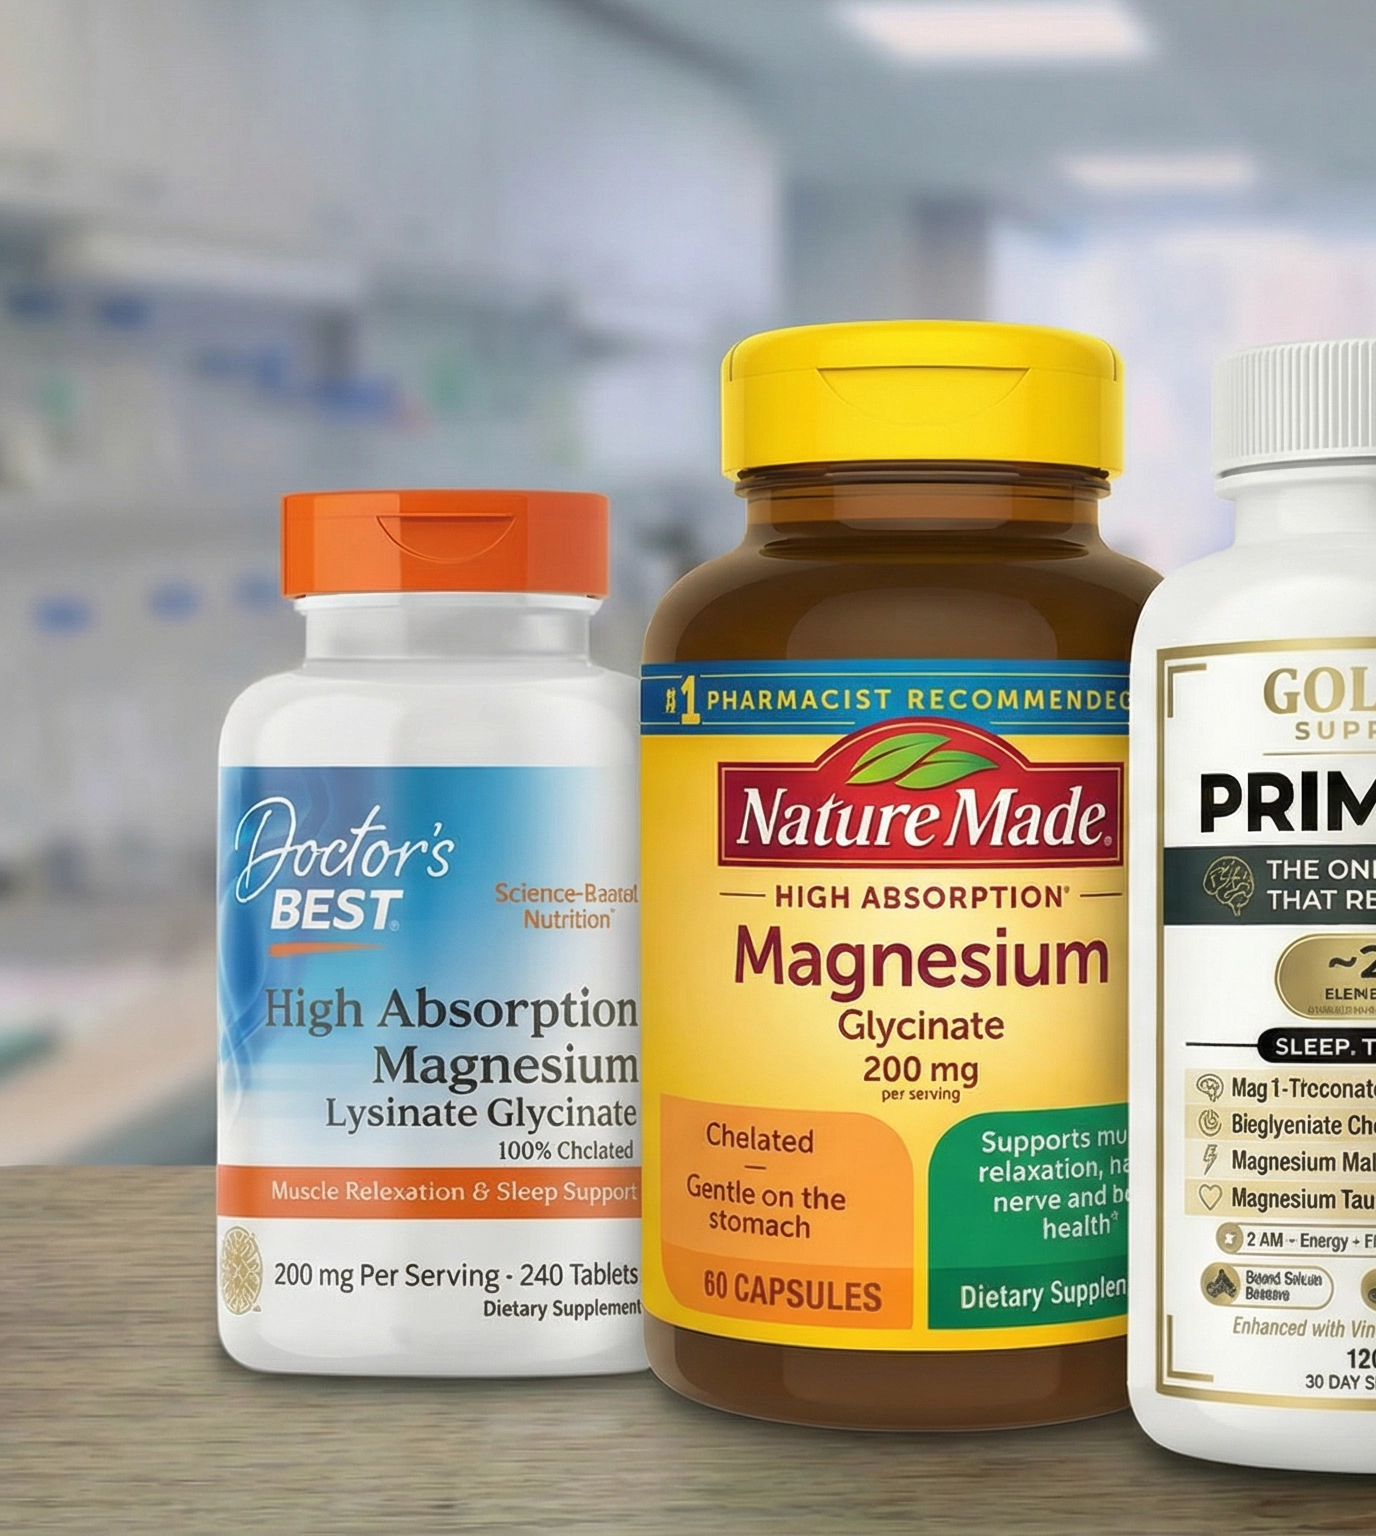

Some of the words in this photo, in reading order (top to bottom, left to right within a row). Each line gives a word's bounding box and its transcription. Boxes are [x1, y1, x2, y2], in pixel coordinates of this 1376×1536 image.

[707, 688, 891, 711] PHARMACIST
[736, 787, 939, 847] Nature
[235, 796, 455, 903] Doctor's
[1267, 859, 1320, 880] THE
[270, 889, 404, 930] BEST
[775, 885, 850, 909] HIGH
[1267, 890, 1337, 911] THAT
[735, 925, 1109, 1001] Magnesium
[265, 987, 363, 1037] High
[377, 986, 639, 1038] Absorption
[838, 1009, 1005, 1047] Glycinate
[1275, 1037, 1356, 1056] SLEEP.
[373, 1044, 640, 1094] Magnesium
[863, 1056, 921, 1082] 200
[930, 1061, 979, 1088] mg
[882, 1088, 905, 1102] per
[909, 1087, 960, 1103] serving
[326, 1097, 477, 1135] Lysinate
[487, 1096, 637, 1134] Glycinate
[499, 1140, 552, 1160] 100%
[706, 1122, 814, 1154] Chelated
[982, 1129, 1091, 1158] Supports
[979, 1158, 1104, 1183] relaxation,
[1232, 1150, 1336, 1175] Magnesium
[271, 1180, 339, 1201] Muscle
[472, 1181, 490, 1201] &
[497, 1180, 558, 1206] Sleep
[563, 1181, 638, 1206] Support
[687, 1173, 755, 1205] Gentle
[761, 1188, 794, 1207] on
[801, 1186, 846, 1211] the
[994, 1193, 1061, 1213] nerve
[1068, 1184, 1107, 1208] and
[1232, 1187, 1336, 1213] Magnesium
[708, 1211, 810, 1239] stomach
[1247, 1232, 1256, 1247] 2
[1260, 1232, 1283, 1247] AM
[1300, 1233, 1349, 1252] Energy
[274, 1263, 313, 1286] 200
[319, 1268, 353, 1293] mg
[360, 1263, 399, 1286] Per
[404, 1263, 500, 1293] Serving
[520, 1263, 563, 1286] 240
[570, 1263, 639, 1286] Tablets
[704, 1270, 728, 1299] 60
[735, 1273, 882, 1312] CAPSULES
[484, 1300, 547, 1318] Dietary
[552, 1299, 642, 1321] Supplement
[961, 1284, 1044, 1312] Dietary
[1233, 1316, 1307, 1336] Enhanced
[1312, 1317, 1345, 1338] with
[1305, 1374, 1324, 1389] 30
[1329, 1374, 1360, 1390] DAY
